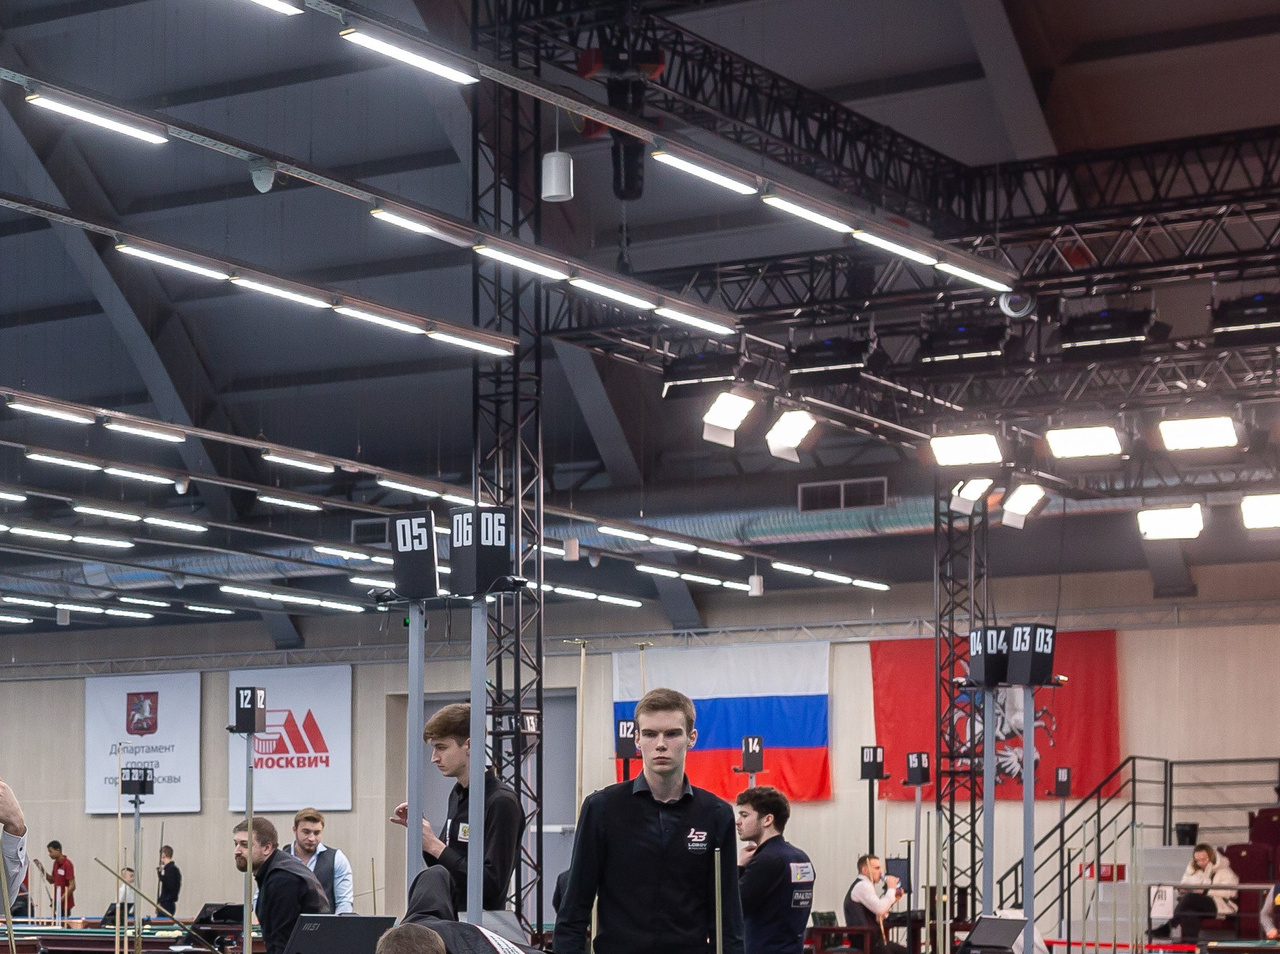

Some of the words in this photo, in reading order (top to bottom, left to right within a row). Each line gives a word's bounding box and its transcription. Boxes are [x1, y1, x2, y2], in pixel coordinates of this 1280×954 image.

[396, 517, 428, 552] 05
[453, 513, 472, 547] 06
[481, 512, 505, 547] 06
[971, 630, 982, 656] 04
[987, 629, 1008, 654] 04
[1012, 626, 1031, 652] 03
[1035, 627, 1053, 654] 03
[239, 690, 251, 709] 12
[257, 690, 264, 709] 12
[619, 721, 634, 738] 02
[748, 737, 760, 753] 14
[253, 755, 329, 769] МОСКВИЧ
